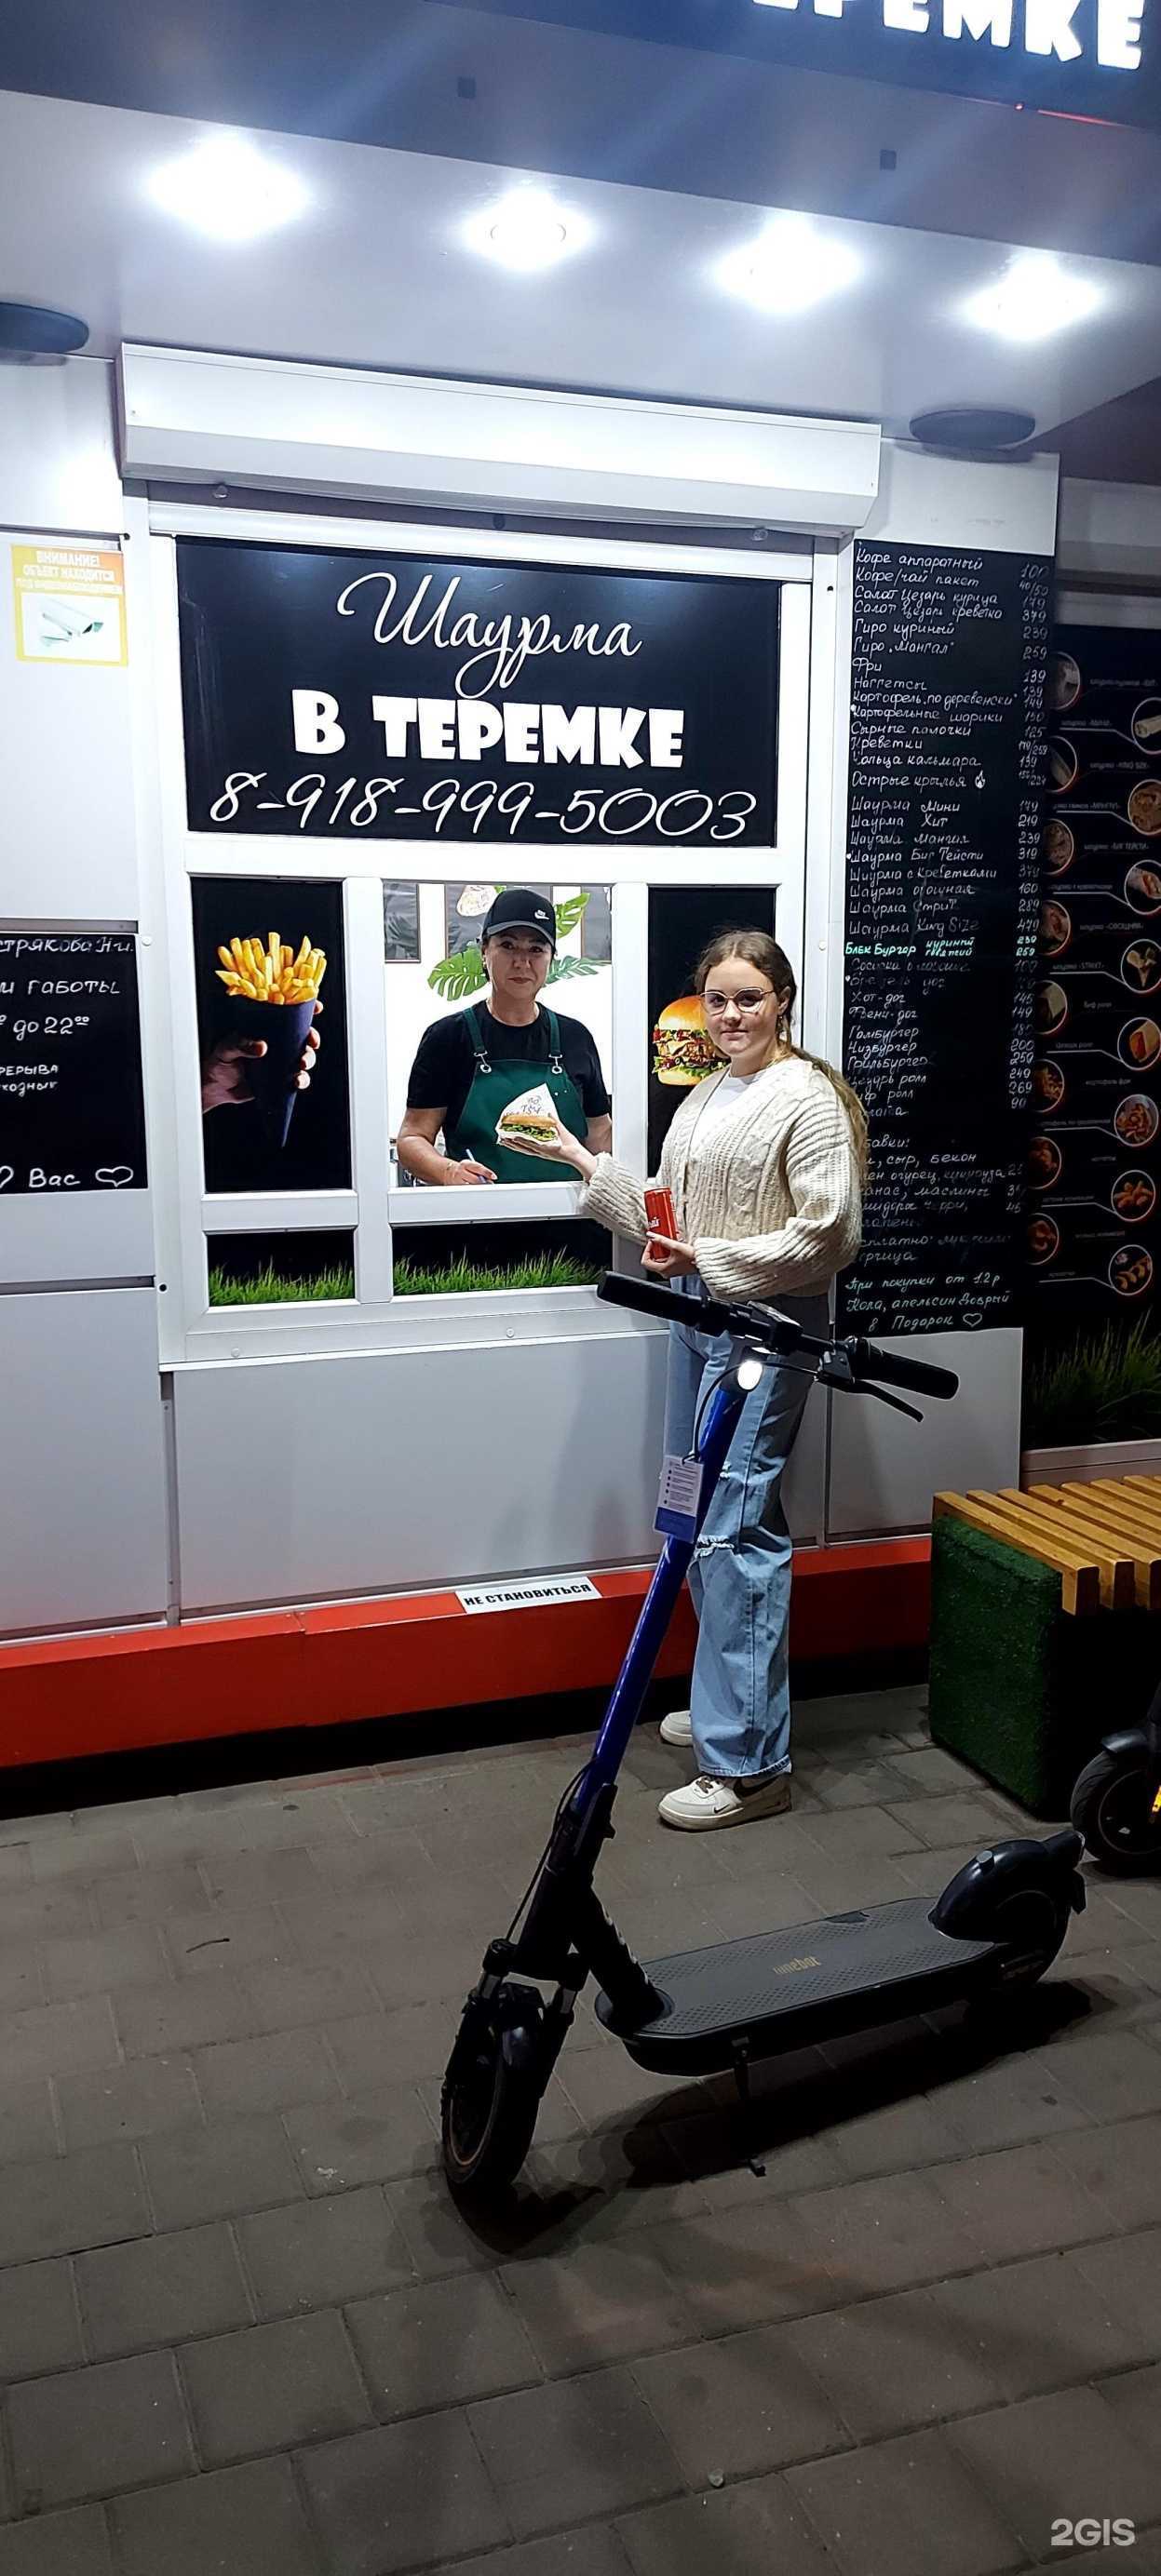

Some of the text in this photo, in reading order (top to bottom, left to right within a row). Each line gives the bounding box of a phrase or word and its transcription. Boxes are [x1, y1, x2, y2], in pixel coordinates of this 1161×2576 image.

[856, 546, 892, 570] Кофе
[935, 575, 980, 588] пакет
[854, 585, 898, 601] Салат
[952, 592, 999, 610] курица
[854, 600, 897, 614] Салат
[336, 570, 643, 700] Шаурма
[854, 619, 887, 639] Гиро
[853, 637, 885, 660] Гиро
[852, 657, 883, 678] Фри
[290, 688, 686, 770] В ТЕРЕМКЕ
[851, 721, 908, 740] Сырные
[907, 755, 982, 772] кальмара
[851, 771, 911, 792] Острые
[208, 771, 758, 841] 8-918-999-5003
[851, 796, 911, 816] Шаурма
[920, 798, 961, 813] Мини
[850, 812, 1039, 835] Шаурма Хит 219
[1019, 831, 1041, 844] 239
[850, 851, 903, 871] Шаурма
[911, 848, 935, 862] Биг
[1018, 847, 1038, 860] 319
[849, 869, 903, 888] Шаурма
[849, 884, 904, 905] Шаурма
[849, 900, 908, 920] Шаурма
[848, 920, 910, 940] Шаурма
[13, 1020, 39, 1041] до
[1010, 1039, 1034, 1052] 200
[898, 1075, 927, 1090] ролл
[887, 1089, 914, 1104] ролл
[930, 1153, 977, 1164] бекон
[28, 1167, 81, 1188] Вас
[862, 1186, 908, 1203] анас,
[945, 1274, 965, 1284] от
[891, 1296, 956, 1309] апельсин
[891, 1315, 954, 1332] Подарок
[463, 1583, 593, 1606] НЕ СТАНОВИТЬСЯ
